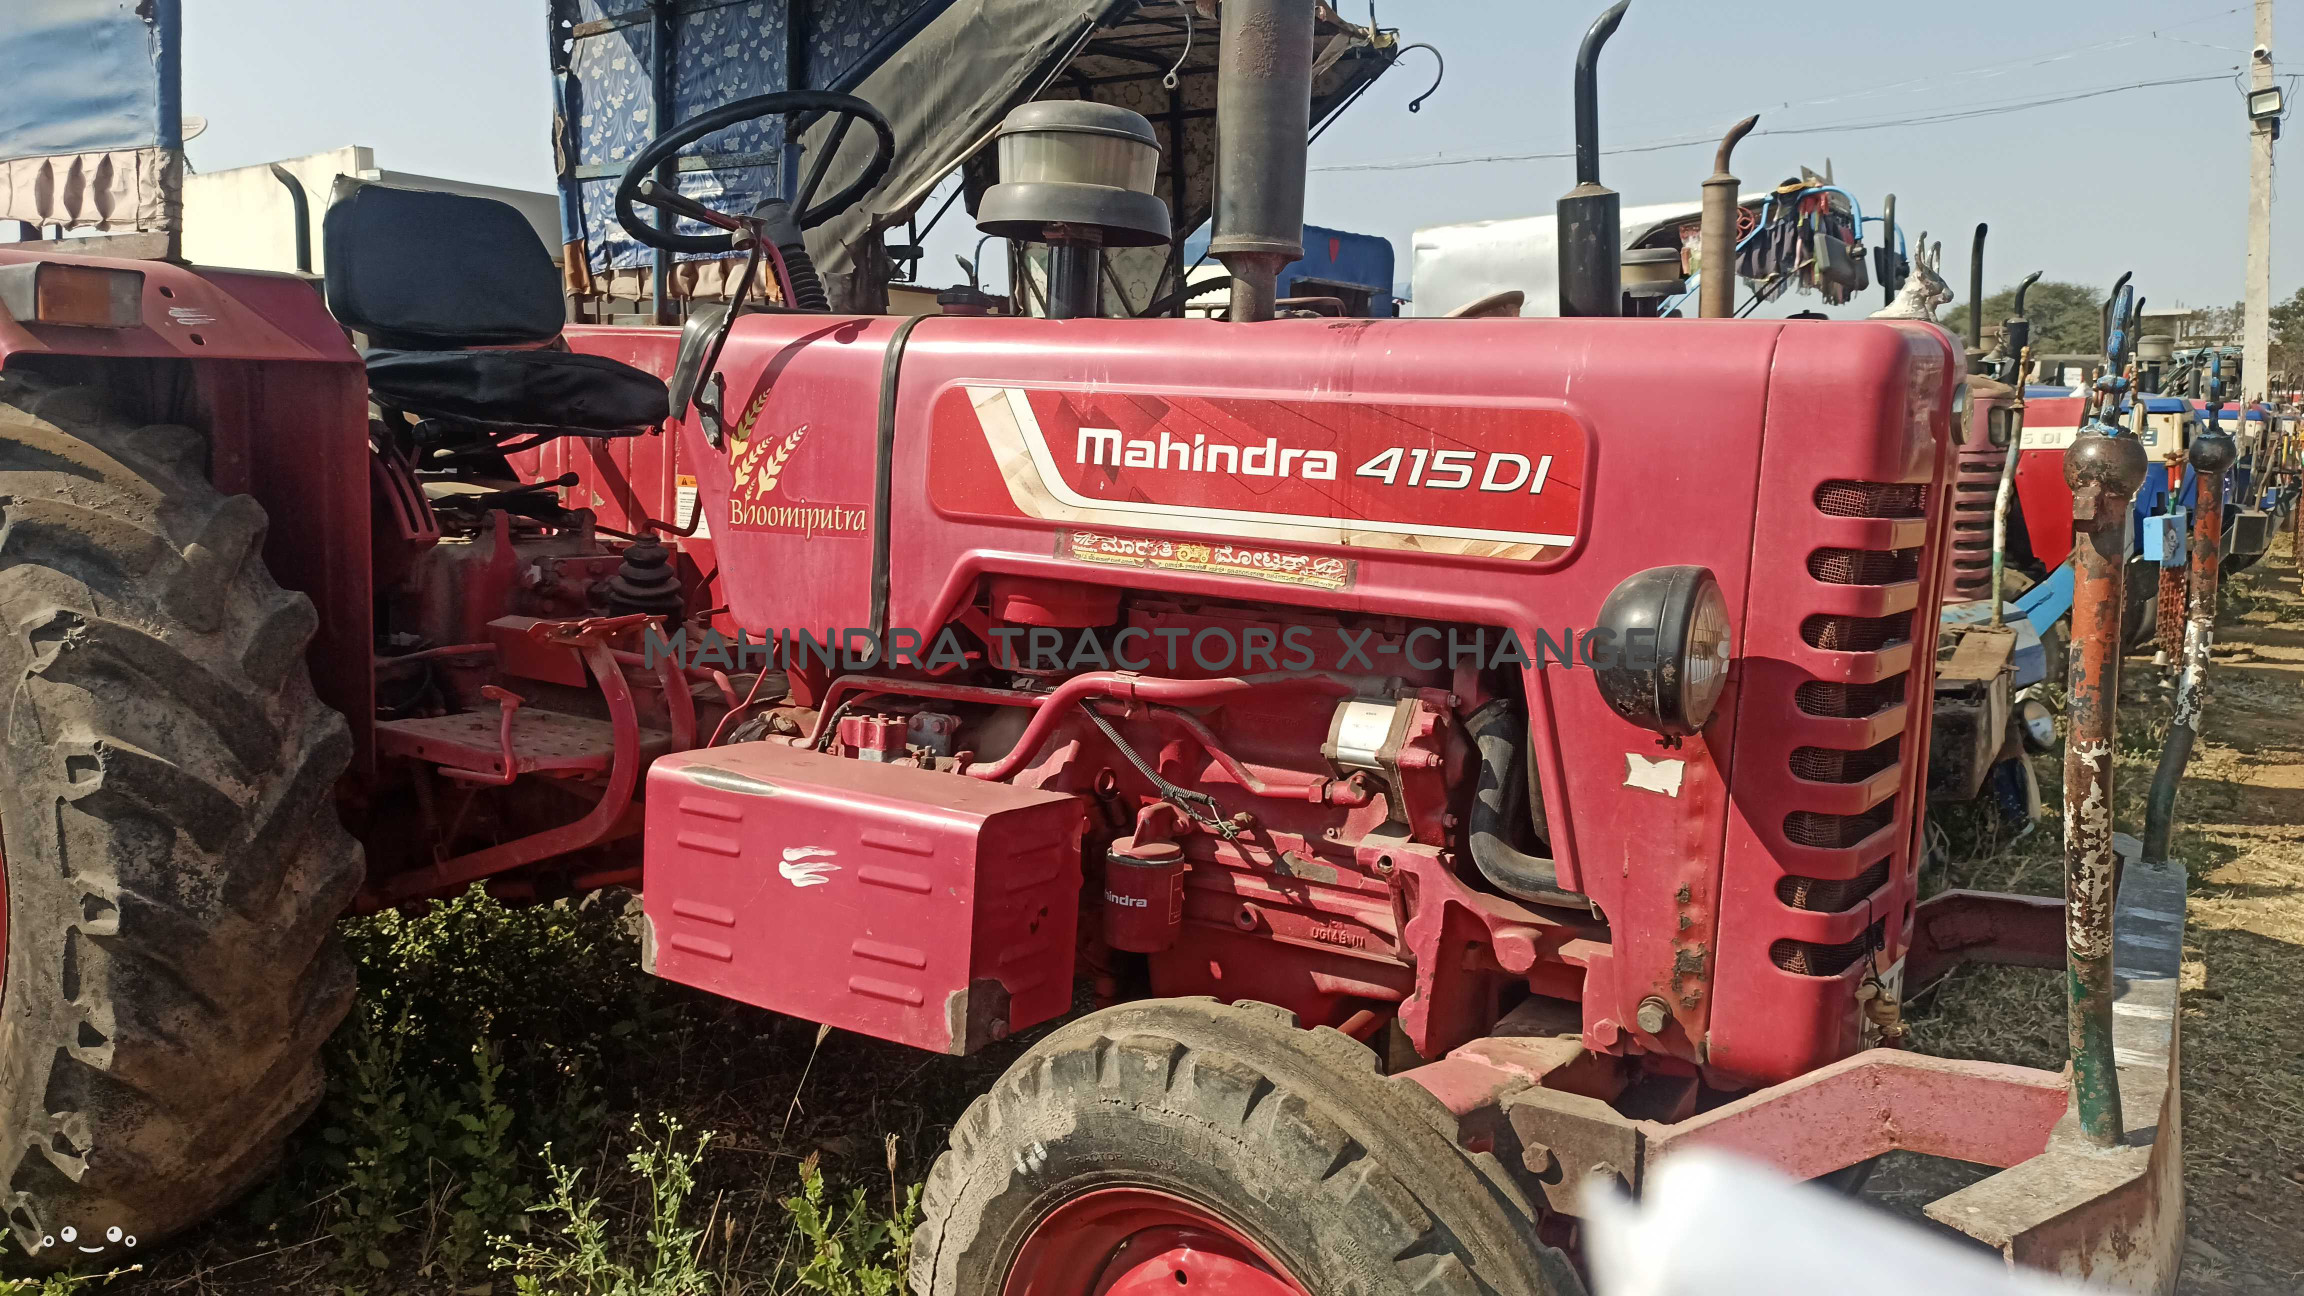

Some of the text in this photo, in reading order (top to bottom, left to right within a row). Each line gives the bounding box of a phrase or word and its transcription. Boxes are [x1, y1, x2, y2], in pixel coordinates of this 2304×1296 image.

[1076, 427, 1554, 495] Mahindra 415 DI
[729, 499, 867, 539] Bhoomiputra
